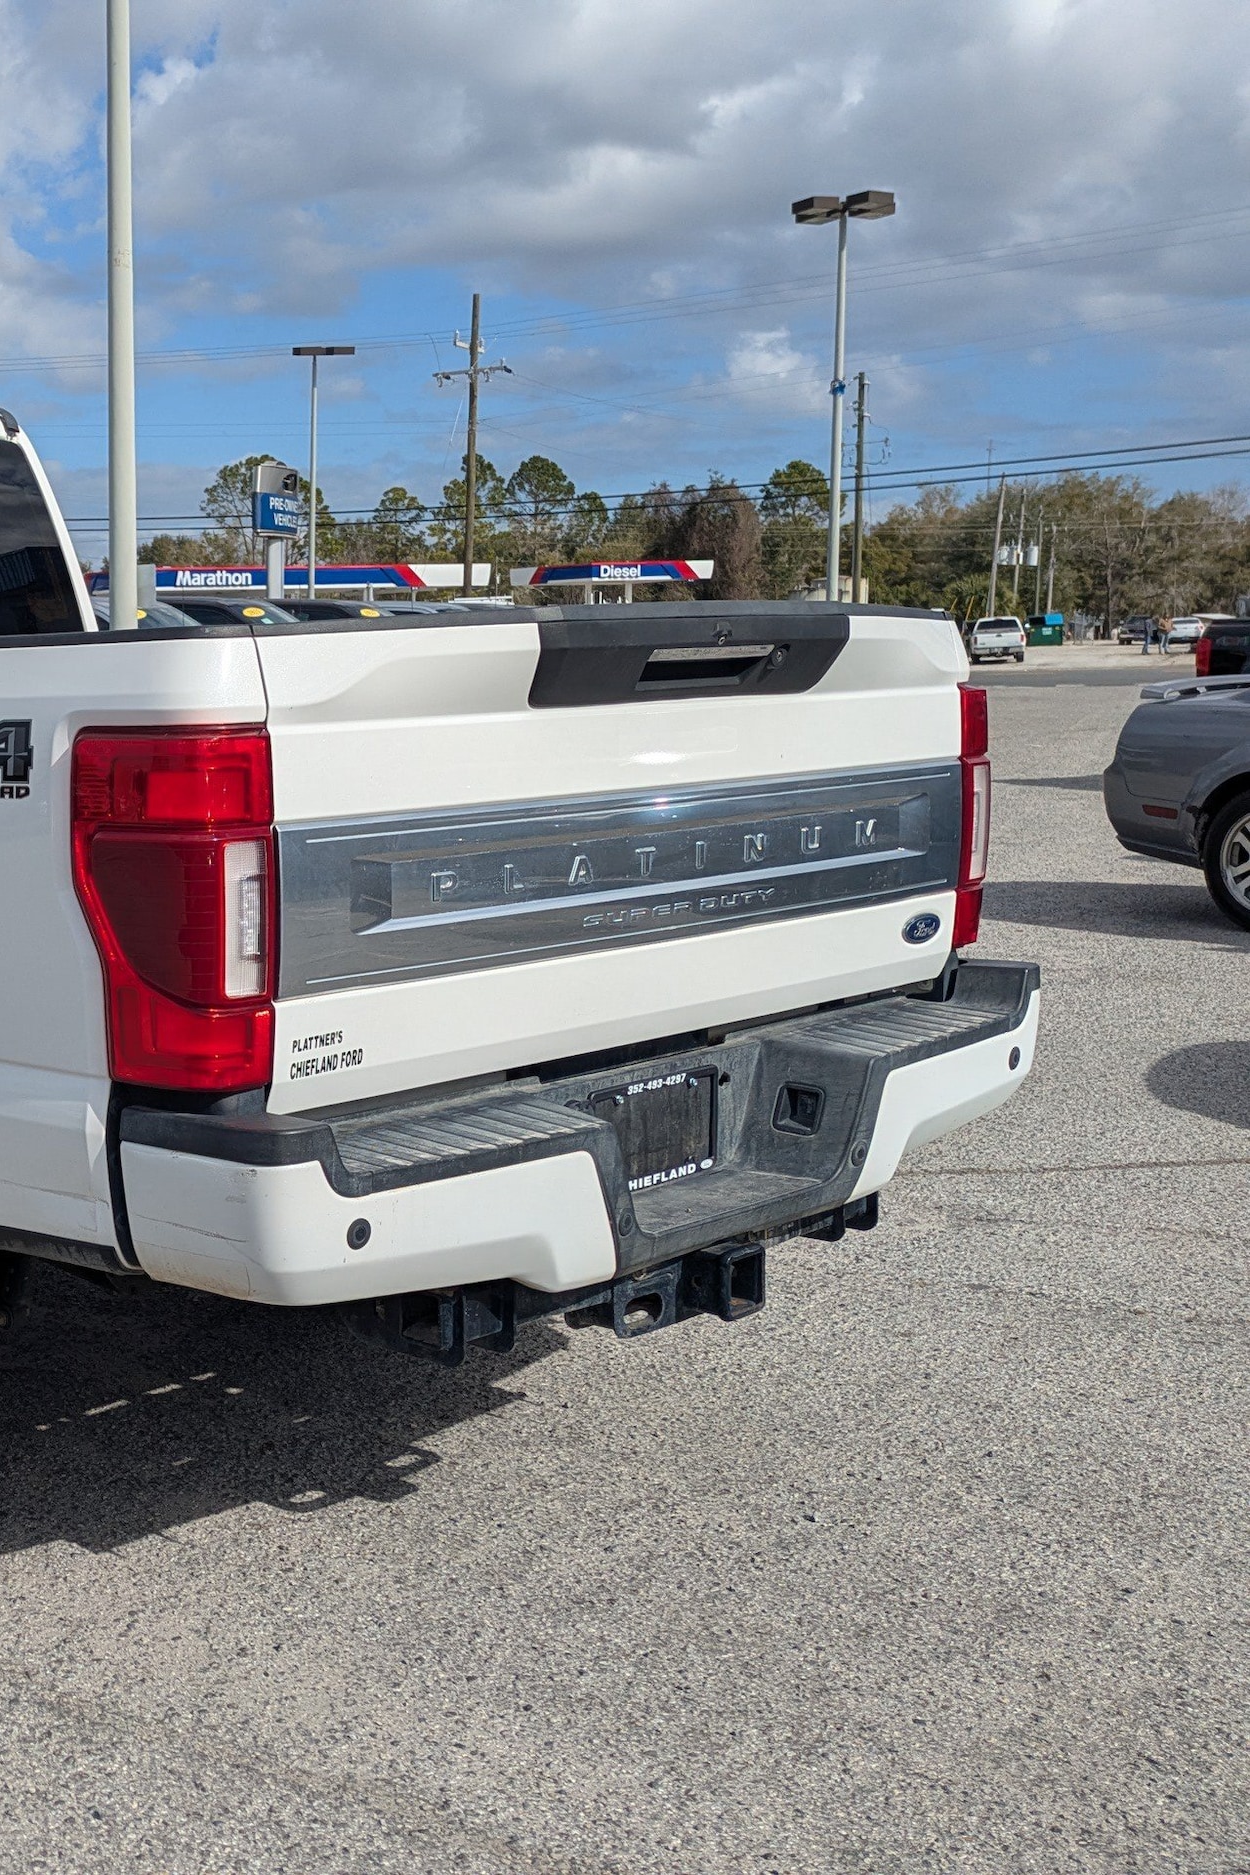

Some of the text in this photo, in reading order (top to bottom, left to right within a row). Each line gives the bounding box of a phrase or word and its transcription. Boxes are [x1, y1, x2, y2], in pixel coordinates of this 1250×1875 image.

[175, 570, 252, 586] Marathon
[600, 564, 642, 578] Diesel
[430, 818, 878, 903] PLATINUM
[583, 888, 775, 928] SUPER DUTY
[292, 1030, 343, 1053] PLATTNER'S
[290, 1048, 363, 1080] CHIEFLAND FORD
[627, 1073, 687, 1095] 352-493-4297
[628, 1163, 696, 1191] HIEFLAND
